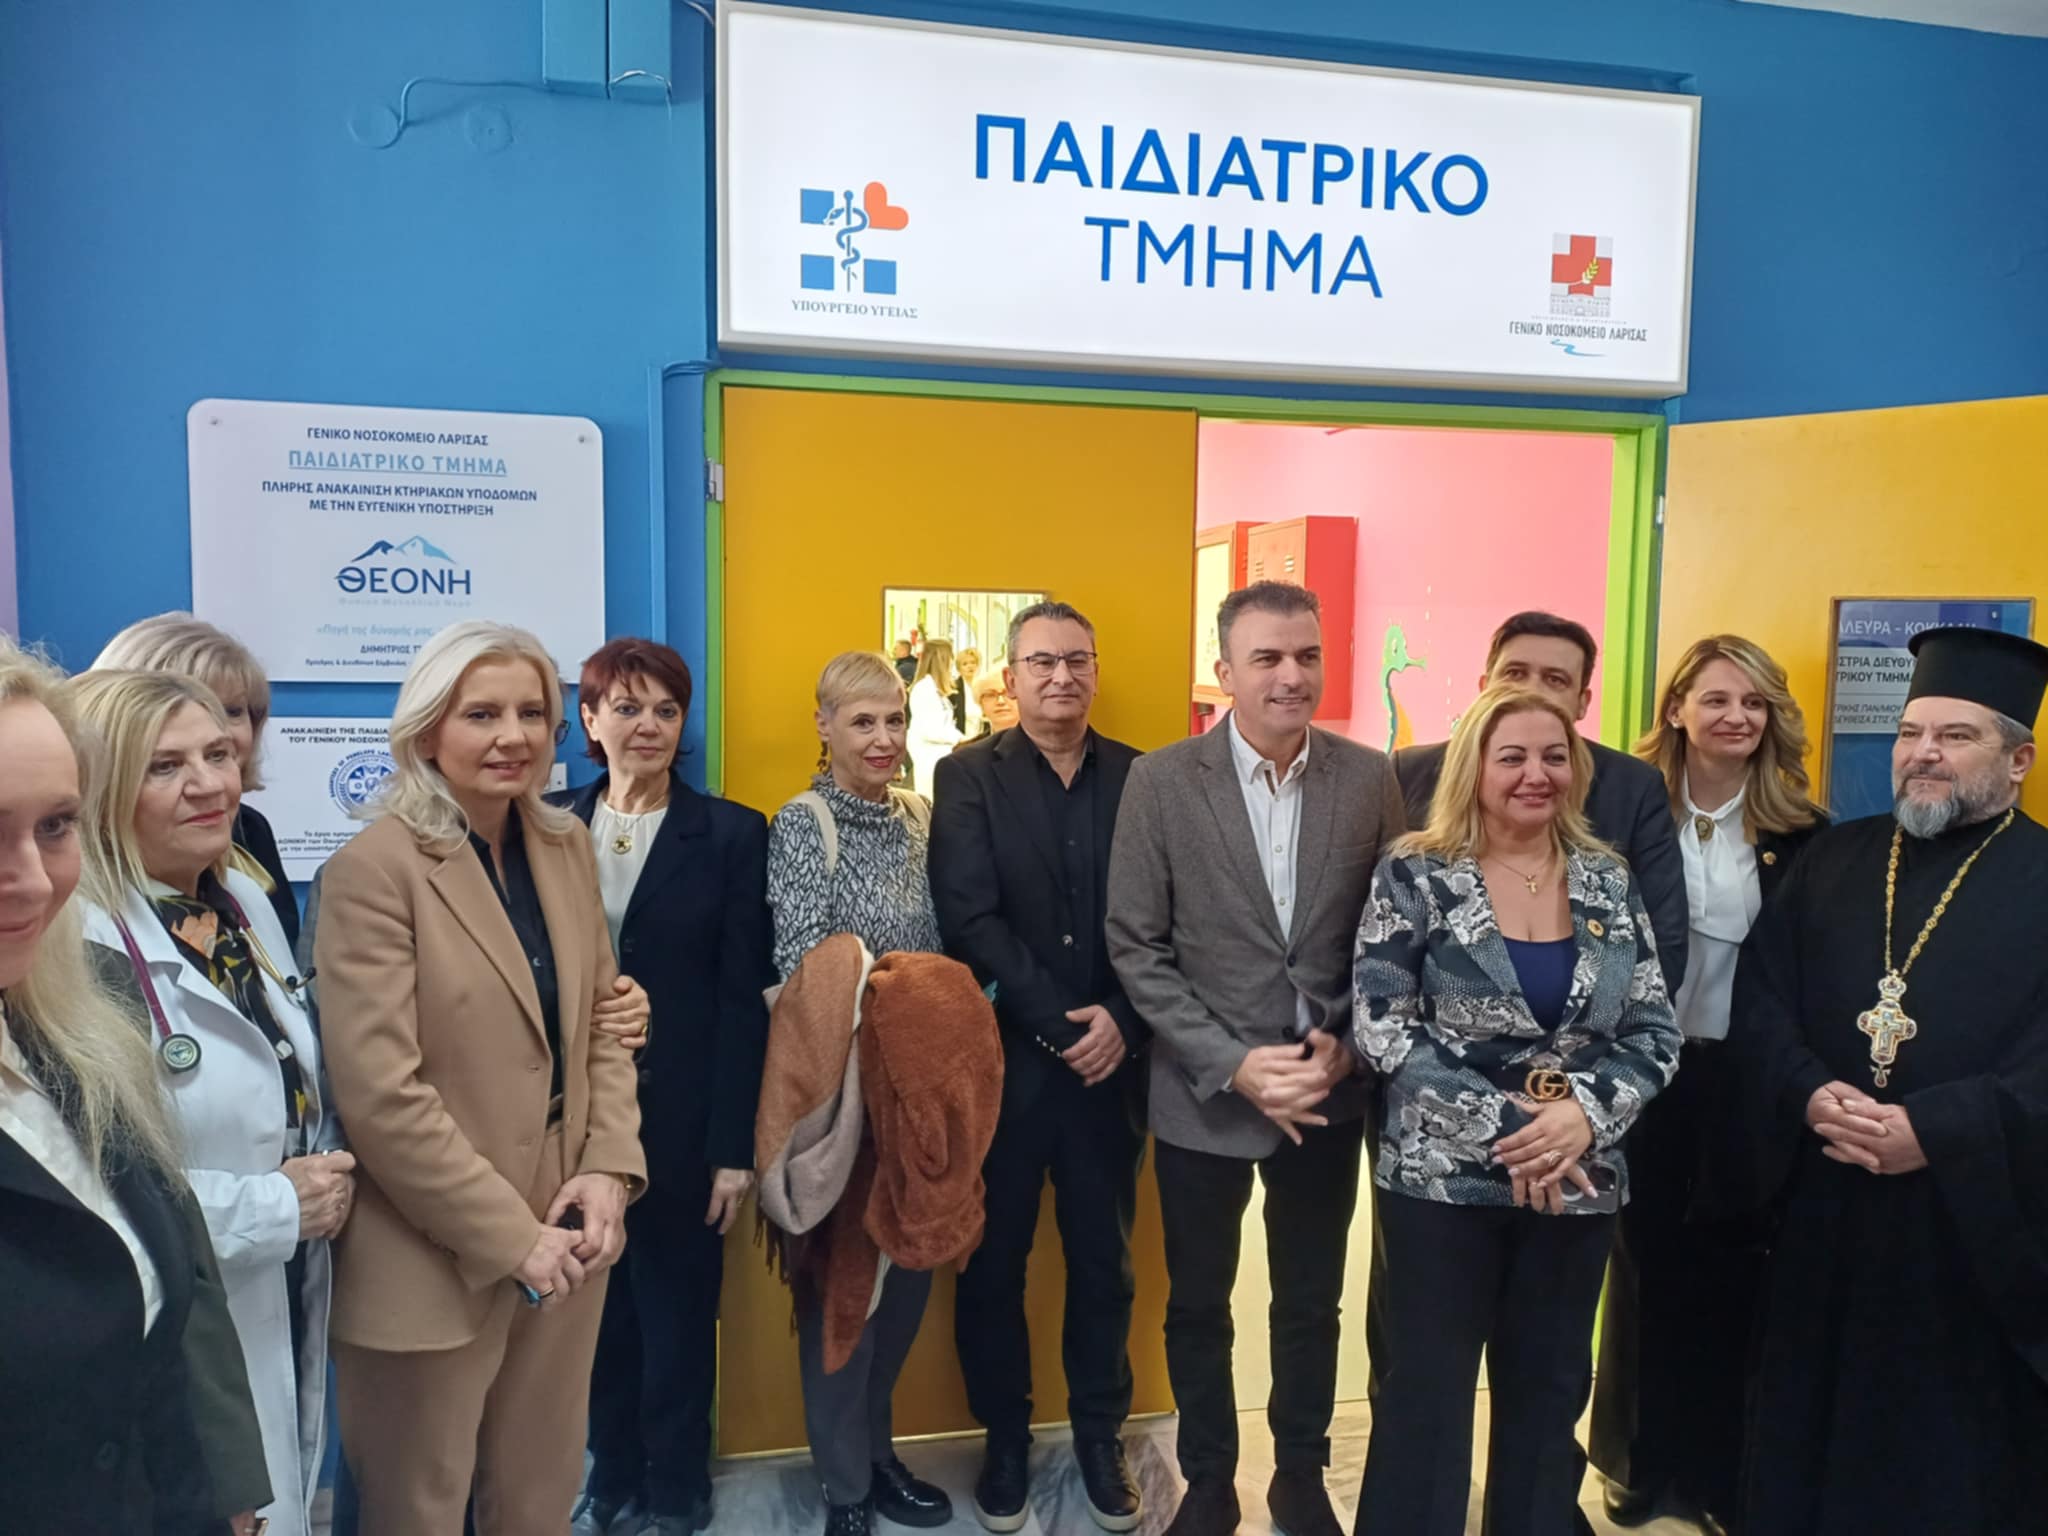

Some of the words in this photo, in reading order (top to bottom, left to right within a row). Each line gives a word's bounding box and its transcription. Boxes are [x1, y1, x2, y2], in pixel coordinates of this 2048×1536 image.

[974, 113, 1489, 217] ΠΑΙΔΙΑΤΡΙΚΟ
[1084, 216, 1383, 299] ΤΜΗΜΑ
[792, 299, 868, 315] ΥΠΟΥΡΓΕΙΟ
[871, 304, 918, 319] ΥΓΕΙΑΣ
[1509, 320, 1543, 336] ΓΕΝΙΚΟ
[1545, 322, 1606, 339] ΝΟΣΟΚΟΜΕΙΟ
[1608, 327, 1648, 342] ΛΑΡΙΣΑΣ
[307, 427, 350, 440] ΓΕΝΙΚΟ
[353, 429, 435, 444] ΝΟΣΟΚΟΜΕΙΟ
[438, 434, 489, 446] ΛΑΡΙΣΑΣ
[288, 449, 425, 472] ΠΑΙΔΙΑΤΡΙΚΟ
[432, 455, 508, 475] ΤΜΗΜΑ
[262, 480, 314, 494] ΠΛΗΡΗΣ
[316, 483, 392, 497] ΑΝΑΚΑΙΝΙΣΗ
[394, 486, 464, 499] ΚΤΗΡΙΑΚΩΝ
[466, 488, 537, 501] ΥΠΟΔΟΜΩΝ
[309, 499, 329, 511] ΜΕ
[330, 500, 355, 512] ΤΗΝ
[357, 501, 415, 514] ΕΥΓΕΝΙΚΗ
[418, 503, 494, 516] ΥΠΟΣΤΗΡΙΞΗ
[334, 566, 471, 595] ΘΕΟΝΗ
[360, 644, 411, 655] ΔΗΜΗΤΡΙΟΣ
[1873, 656, 1913, 668] ΔΙΕΥΘΥ
[1876, 672, 1911, 682] ΤΜΗΜ
[280, 727, 337, 735] ΑΝΑΚΑΙΝΙΣΗ
[339, 727, 356, 735] ΤΗΣ
[309, 736, 346, 744] ΓΕΝΙΚΟΥ
[348, 736, 390, 744] ΝΟΣΟΚΟ
